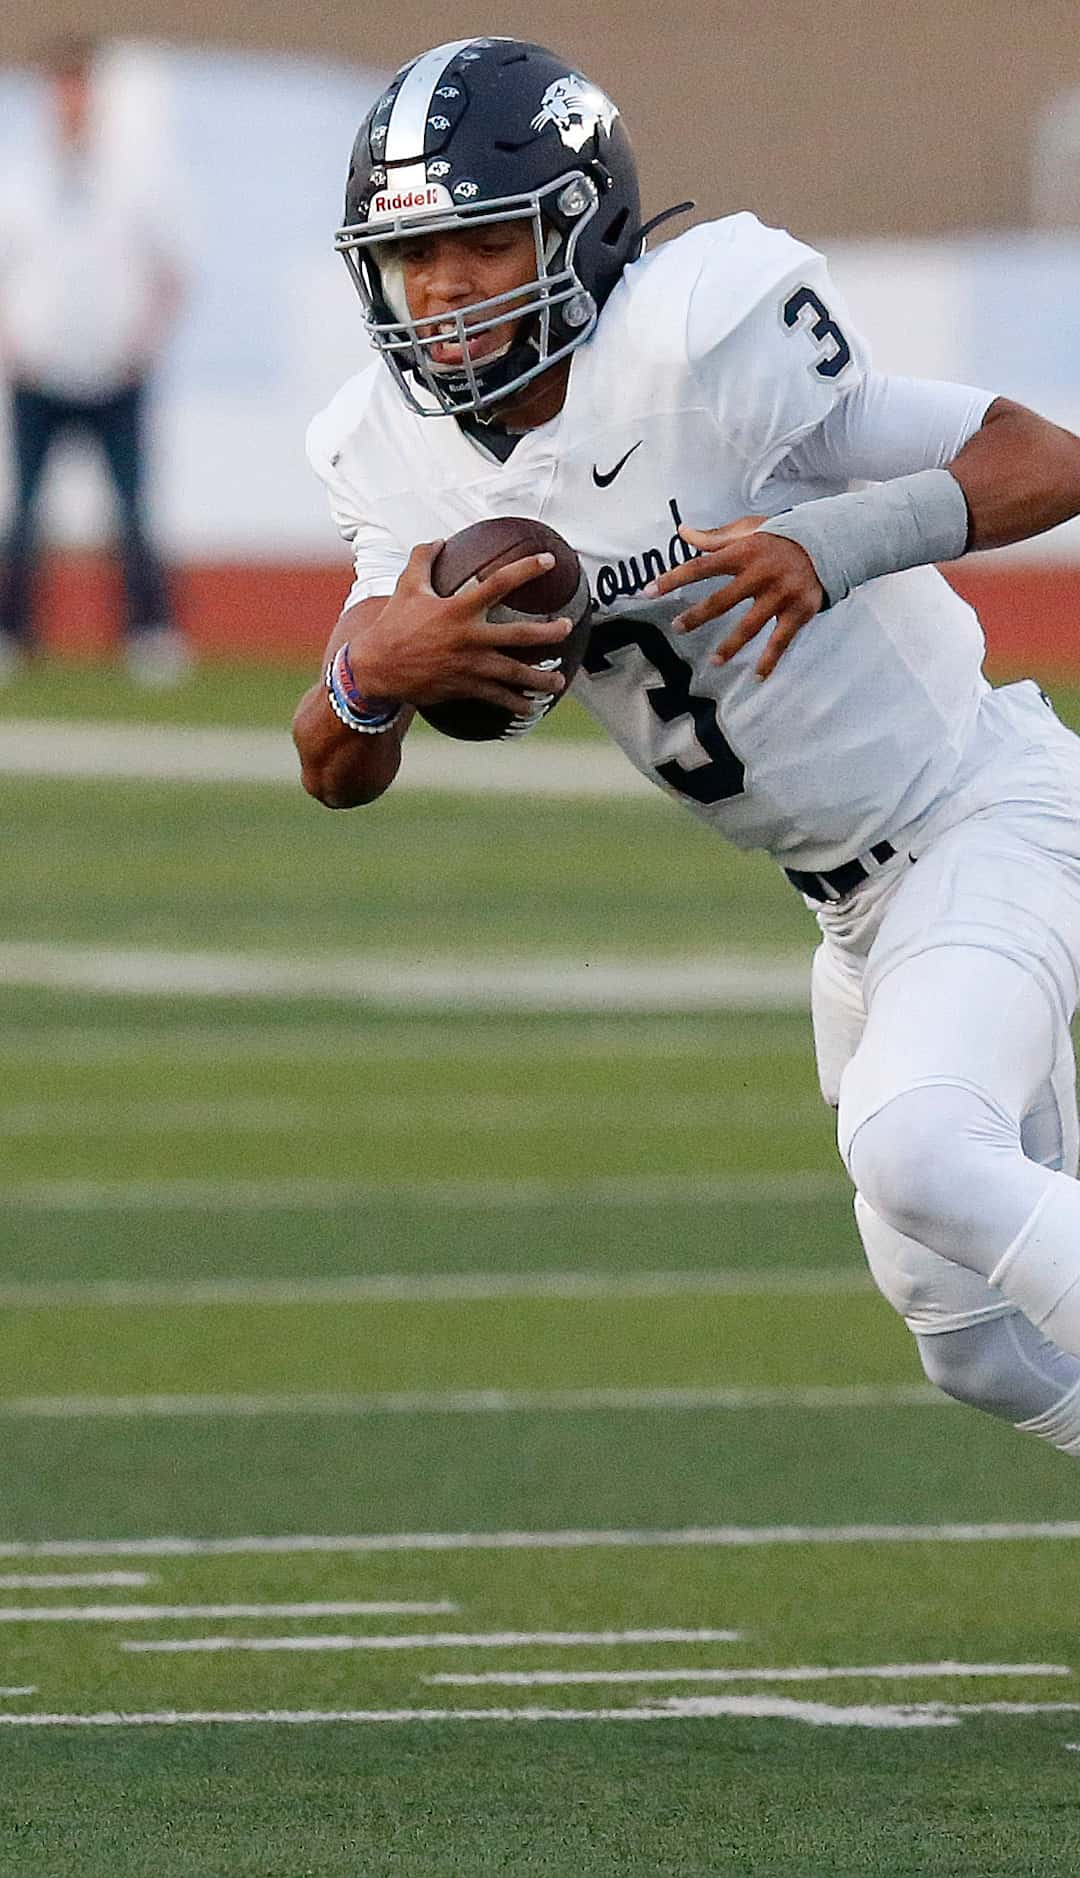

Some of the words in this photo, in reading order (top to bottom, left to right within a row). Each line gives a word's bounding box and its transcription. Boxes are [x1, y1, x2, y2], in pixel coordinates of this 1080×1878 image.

[375, 188, 437, 212] Riddell
[784, 287, 849, 377] 3
[591, 498, 702, 613] ound
[582, 619, 745, 803] 3
